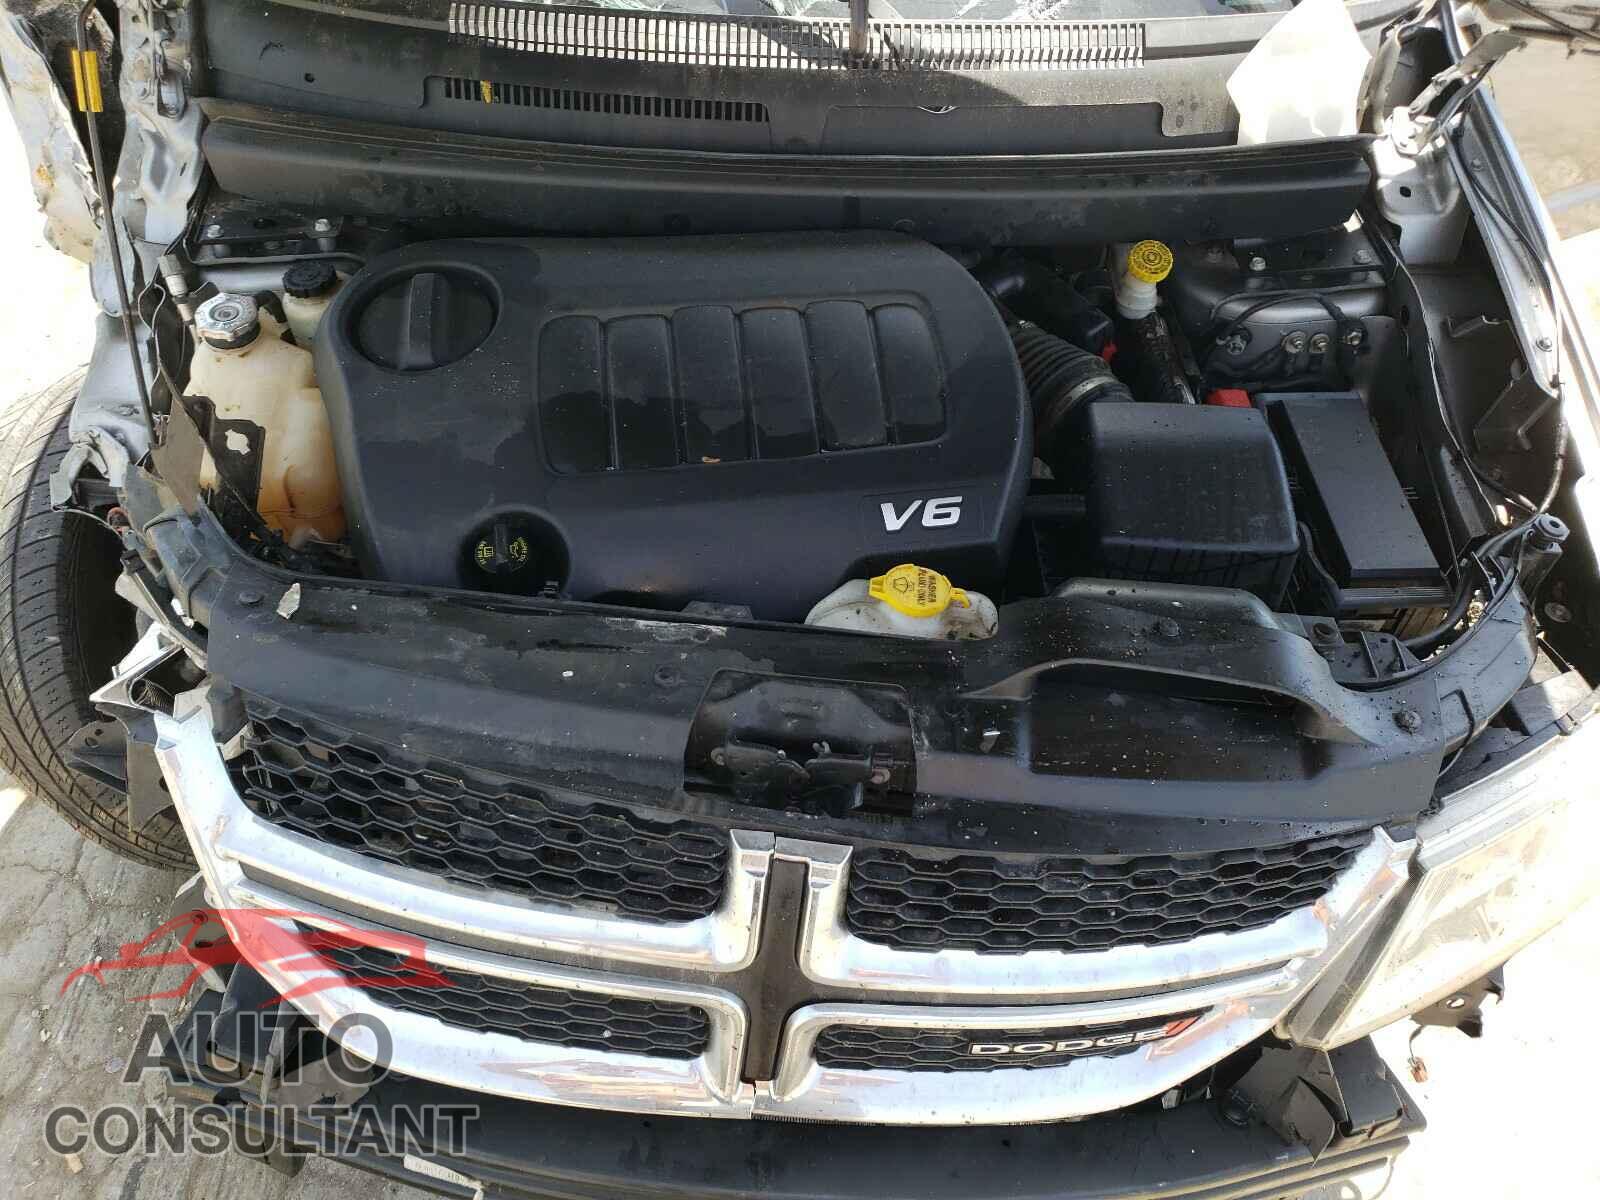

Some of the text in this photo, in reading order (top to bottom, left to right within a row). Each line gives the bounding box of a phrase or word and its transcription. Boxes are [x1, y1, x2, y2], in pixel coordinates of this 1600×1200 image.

[880, 496, 962, 531] V6
[928, 575, 936, 603] WASHER
[970, 1028, 1168, 1055] DODGE
